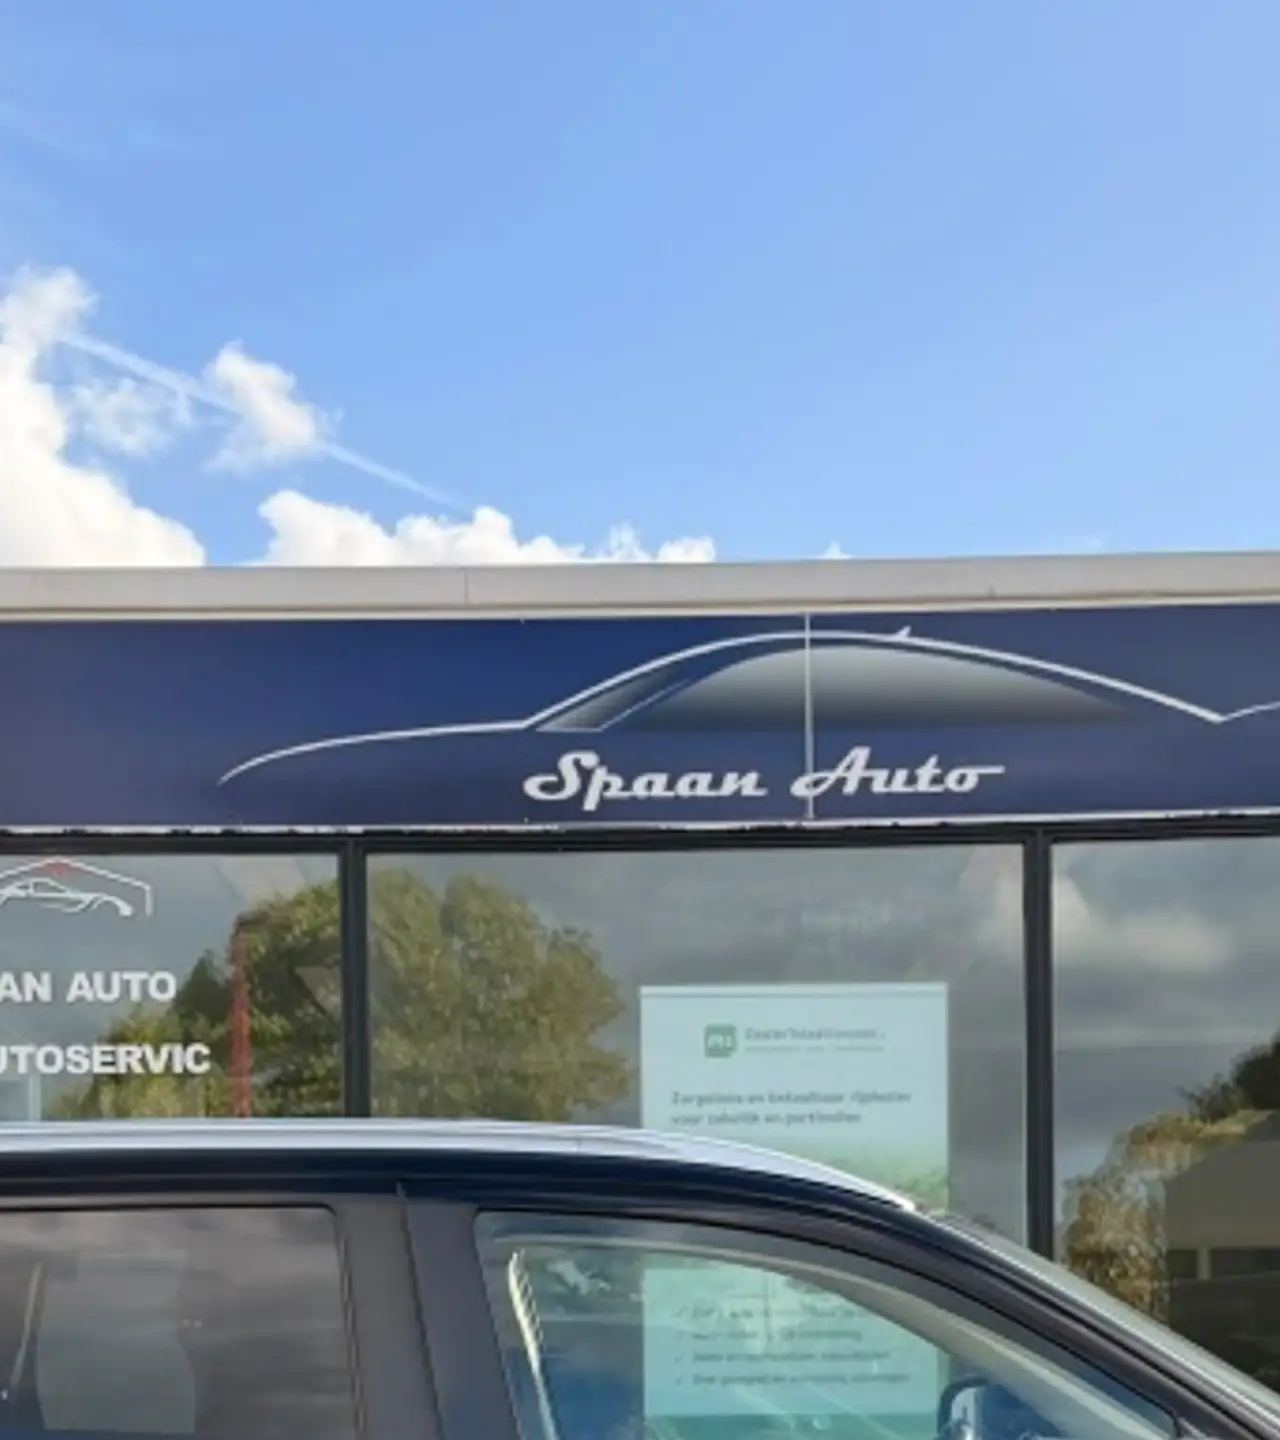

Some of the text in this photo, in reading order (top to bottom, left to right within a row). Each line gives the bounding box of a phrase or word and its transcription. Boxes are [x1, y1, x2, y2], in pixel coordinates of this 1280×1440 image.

[523, 745, 1006, 811] Spaan Auto
[66, 970, 178, 1002] AUTO
